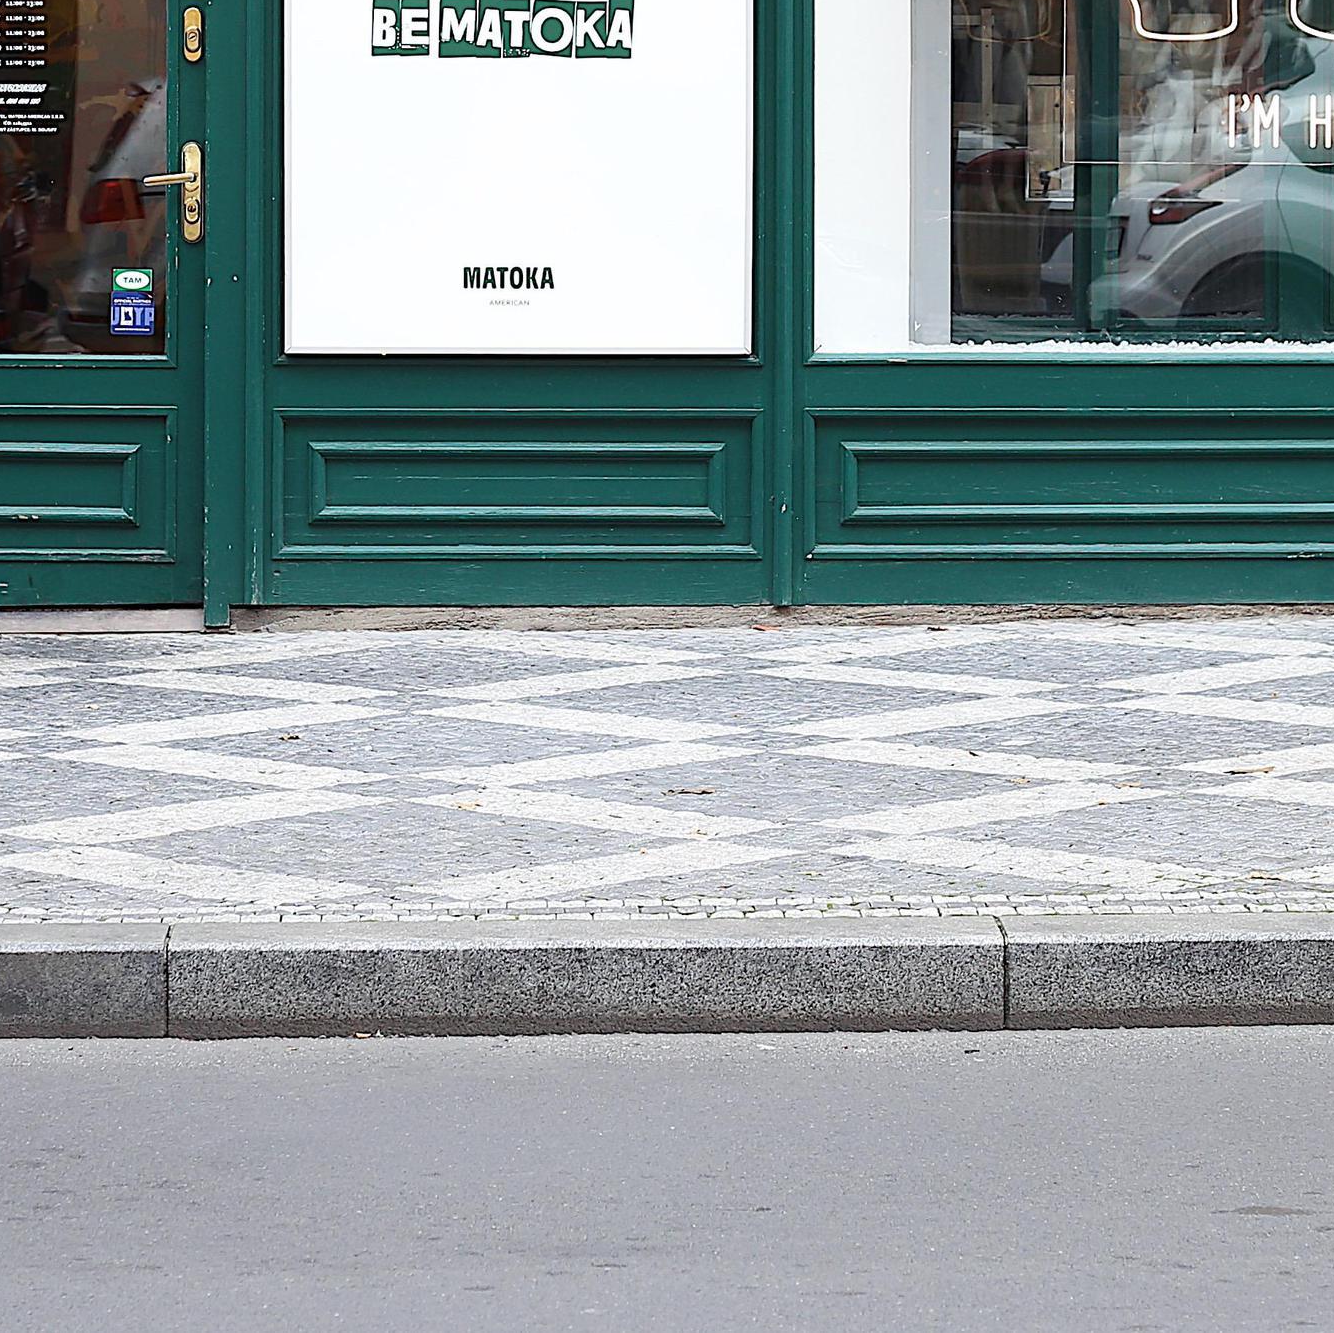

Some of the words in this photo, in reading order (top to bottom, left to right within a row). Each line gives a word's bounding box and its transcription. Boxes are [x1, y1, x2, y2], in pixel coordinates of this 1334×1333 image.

[372, 6, 430, 49] BE
[439, 6, 633, 53] MATOKA
[1227, 93, 1280, 149] I'M
[123, 276, 142, 284] TAM
[463, 266, 555, 289] MATOKA
[489, 299, 530, 307] AMERICAN
